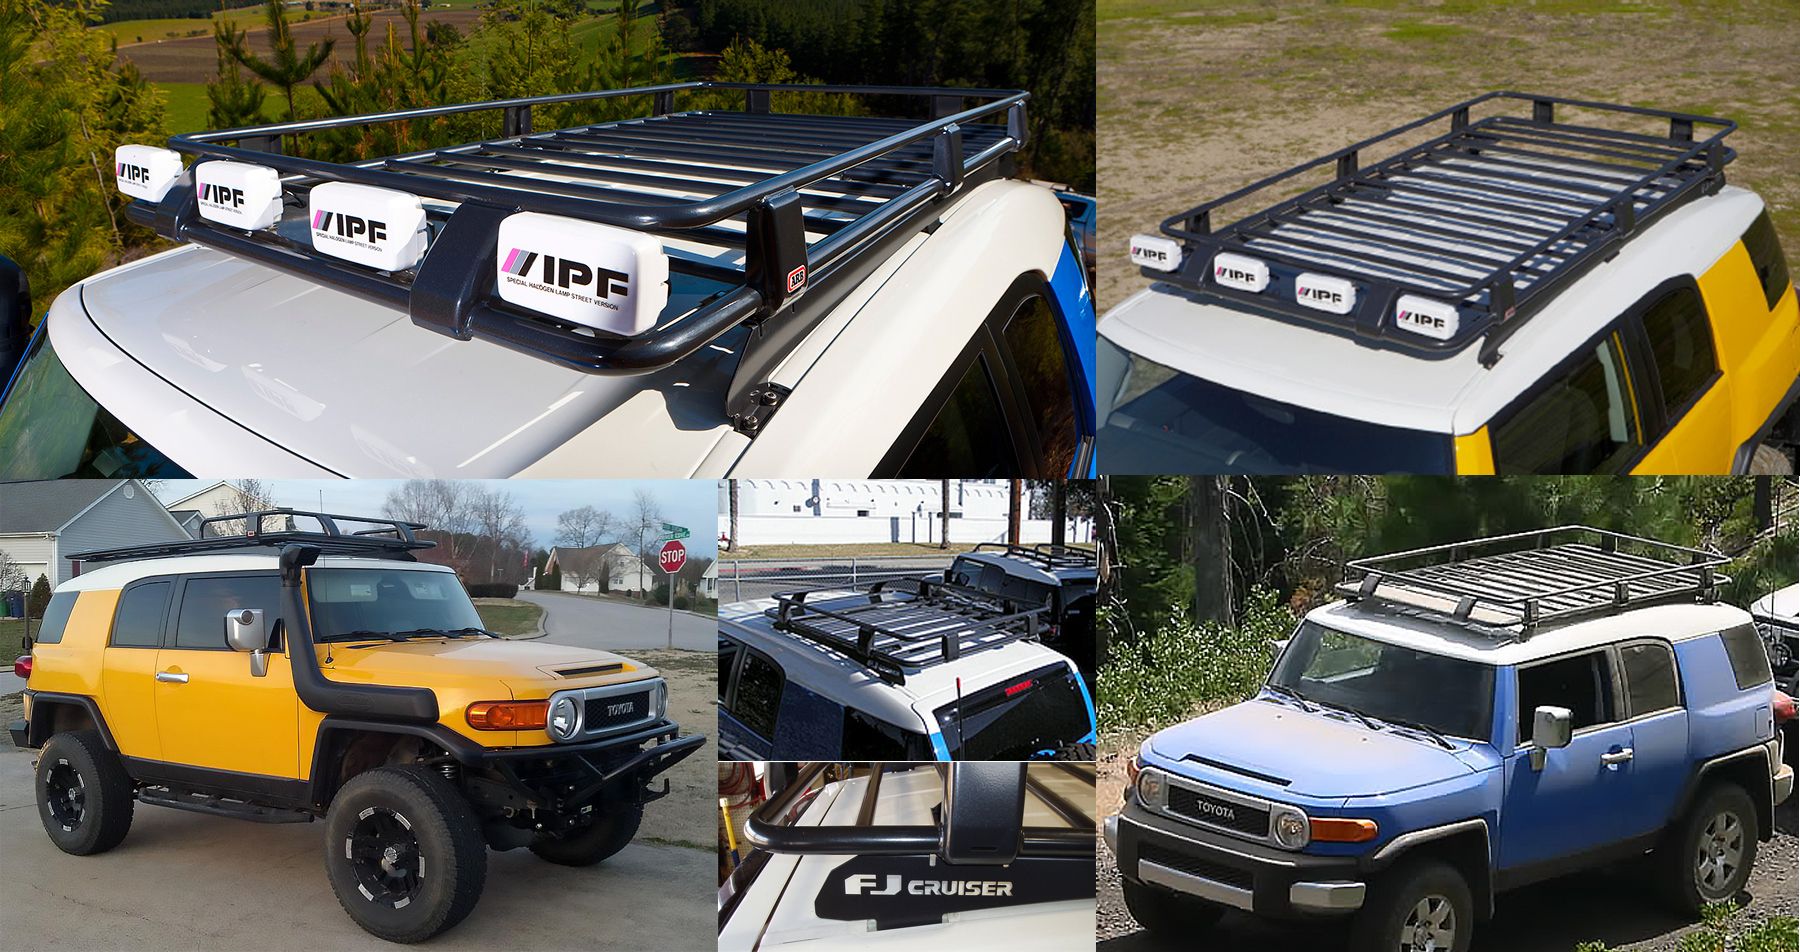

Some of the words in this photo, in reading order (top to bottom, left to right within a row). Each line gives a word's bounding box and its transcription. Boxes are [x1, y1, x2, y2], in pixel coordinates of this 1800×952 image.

[127, 163, 150, 184] IPF
[212, 184, 244, 208] IPF
[336, 212, 387, 244] IPF
[1143, 248, 1167, 261] IPF
[543, 254, 629, 300] IPF
[791, 270, 804, 288] ARB
[1229, 268, 1256, 282] IPF
[506, 276, 528, 287] SPECIAL
[528, 281, 555, 294] HALOGEN
[555, 288, 571, 297] LAMP
[571, 292, 593, 304] STREET
[593, 299, 619, 311] VERSION
[1312, 288, 1342, 303] IPF
[1414, 312, 1445, 329] IPF
[661, 549, 685, 564] STOP
[607, 701, 634, 717] TOYOTA
[1196, 799, 1236, 820] TOYOTA
[844, 874, 902, 896] FJ
[907, 880, 1014, 897] CRUISER
